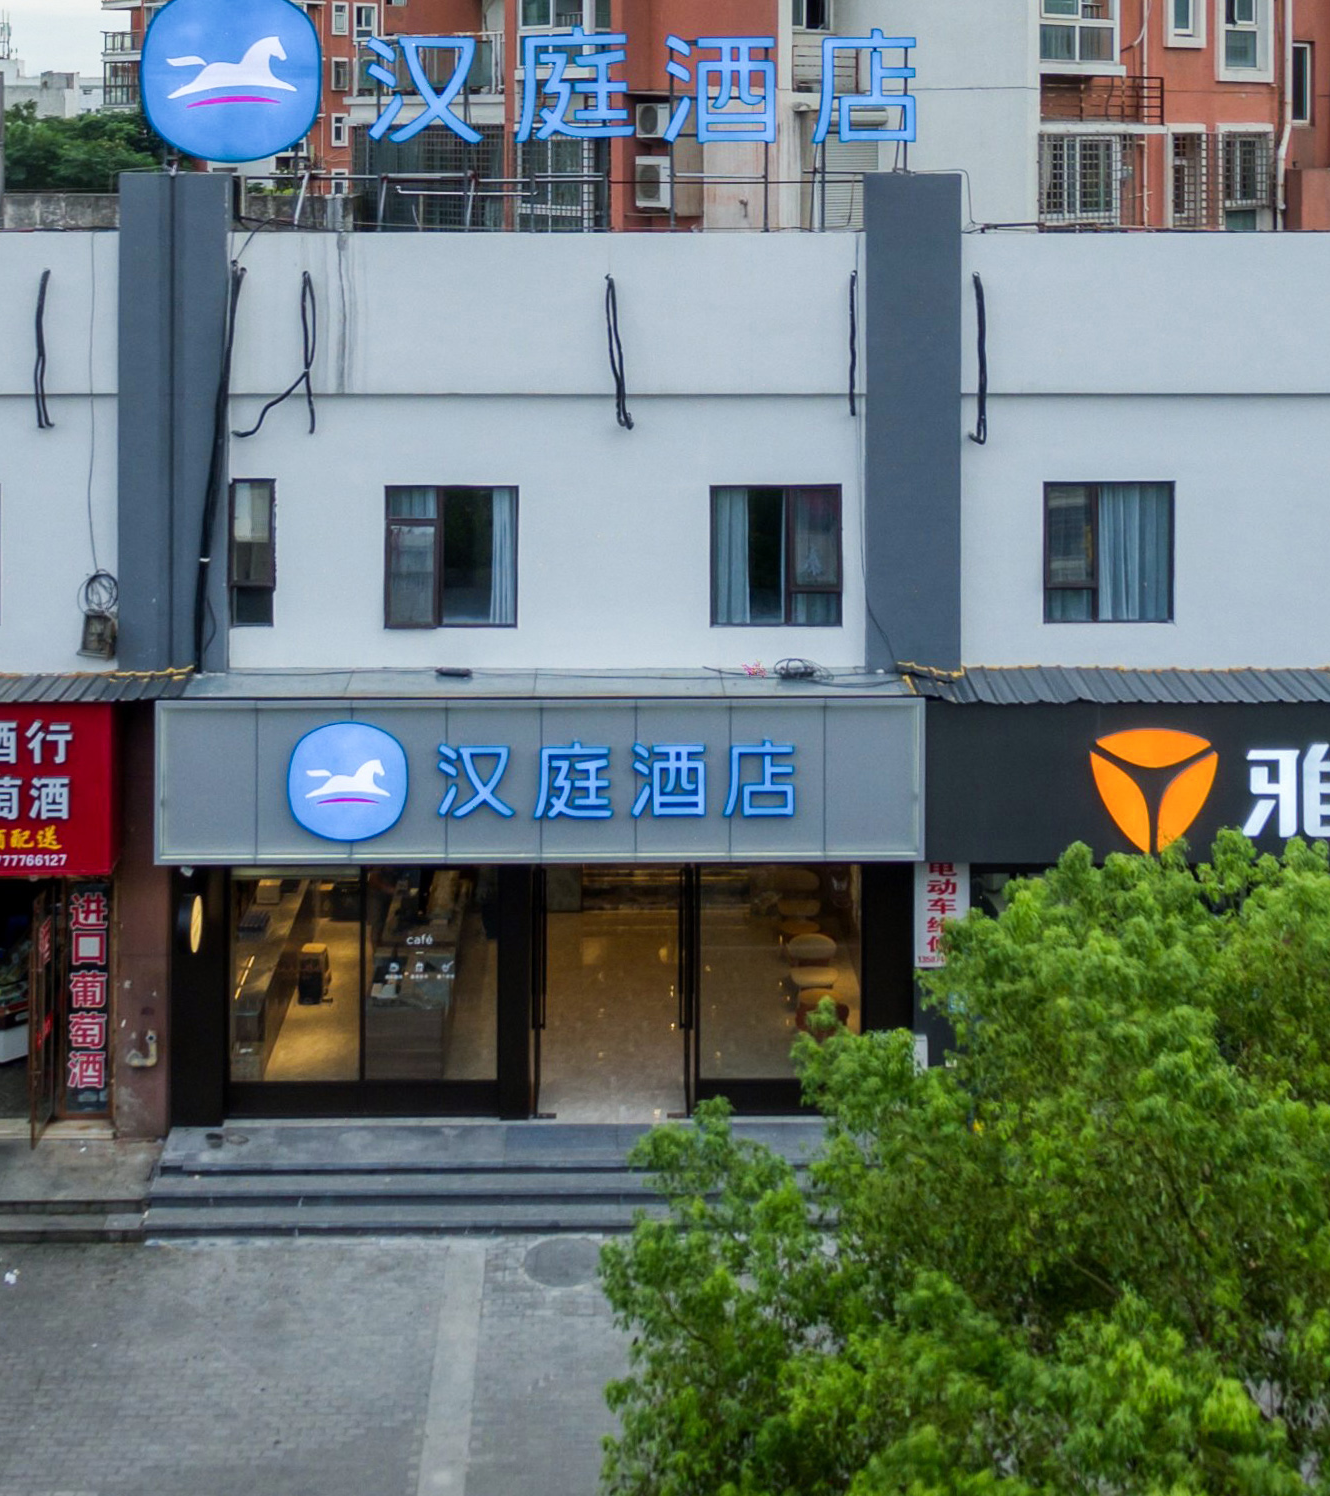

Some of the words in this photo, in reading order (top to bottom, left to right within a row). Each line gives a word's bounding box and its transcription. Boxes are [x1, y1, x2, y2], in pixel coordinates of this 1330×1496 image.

[366, 27, 917, 145] 汉庭酒店
[437, 739, 796, 820] 汉庭酒店
[406, 933, 434, 945] café
[67, 892, 109, 1090] 进口葡萄酒
